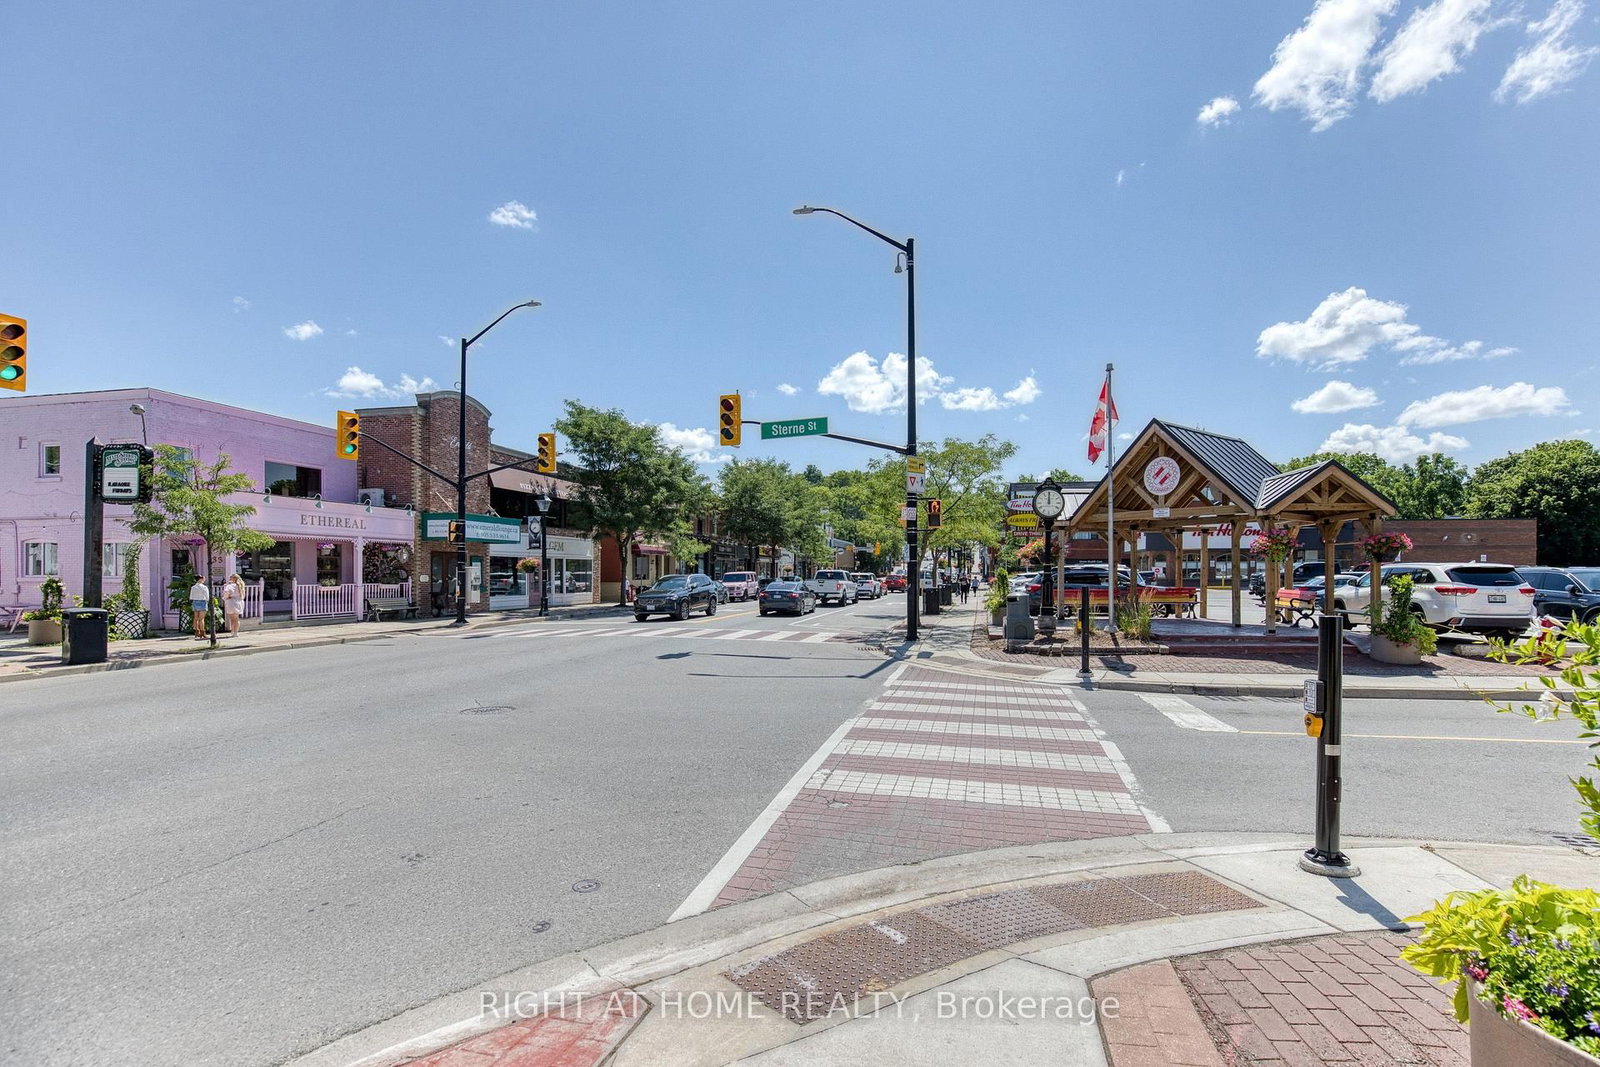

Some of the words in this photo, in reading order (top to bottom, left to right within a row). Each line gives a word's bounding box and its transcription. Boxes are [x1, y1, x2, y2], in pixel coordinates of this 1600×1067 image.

[771, 424, 805, 436] Sterne
[807, 421, 817, 431] St
[300, 514, 367, 530] ETHEREAL
